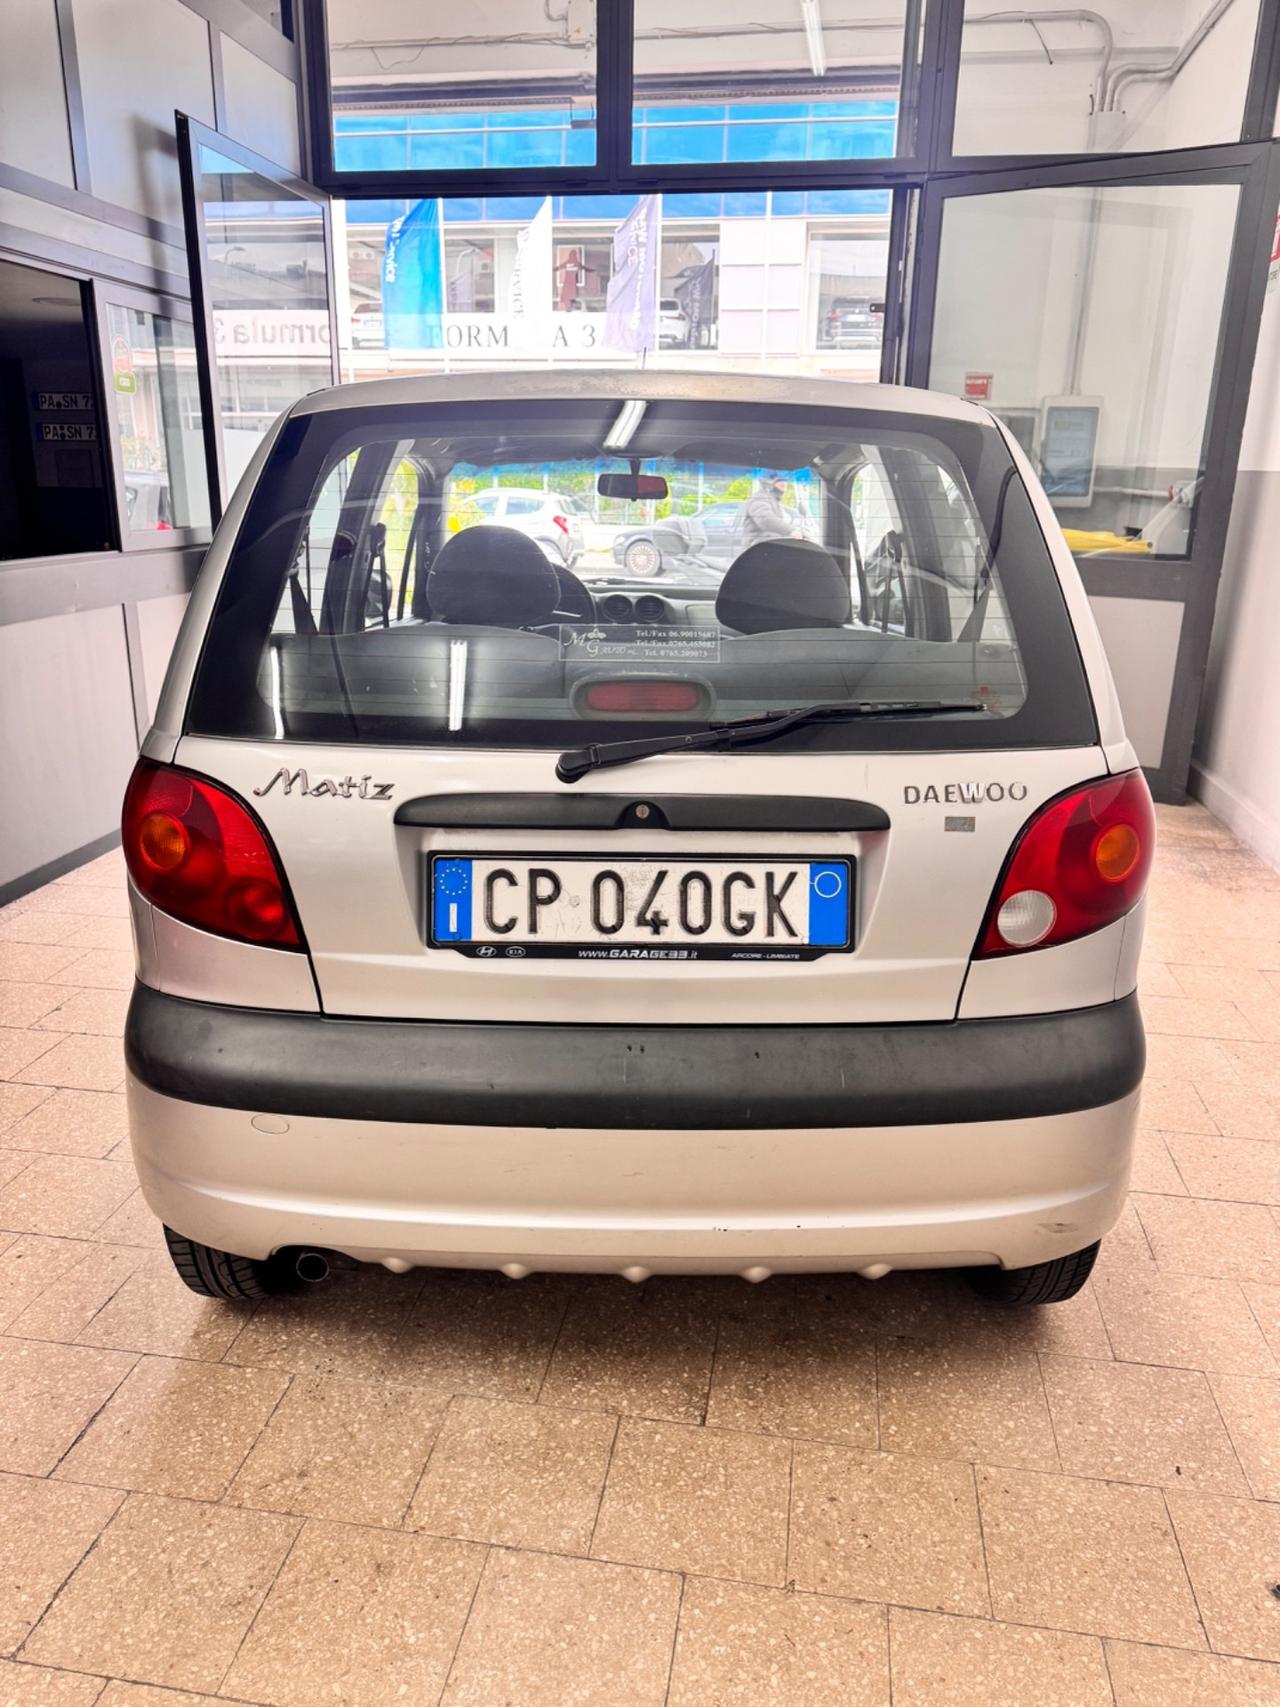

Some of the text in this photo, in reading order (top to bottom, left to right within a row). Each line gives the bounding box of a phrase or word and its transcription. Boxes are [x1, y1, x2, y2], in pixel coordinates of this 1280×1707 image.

[582, 324, 596, 348] 3
[253, 767, 395, 800] Matiz
[904, 782, 1028, 805] DAEWOO
[483, 867, 562, 935] CP
